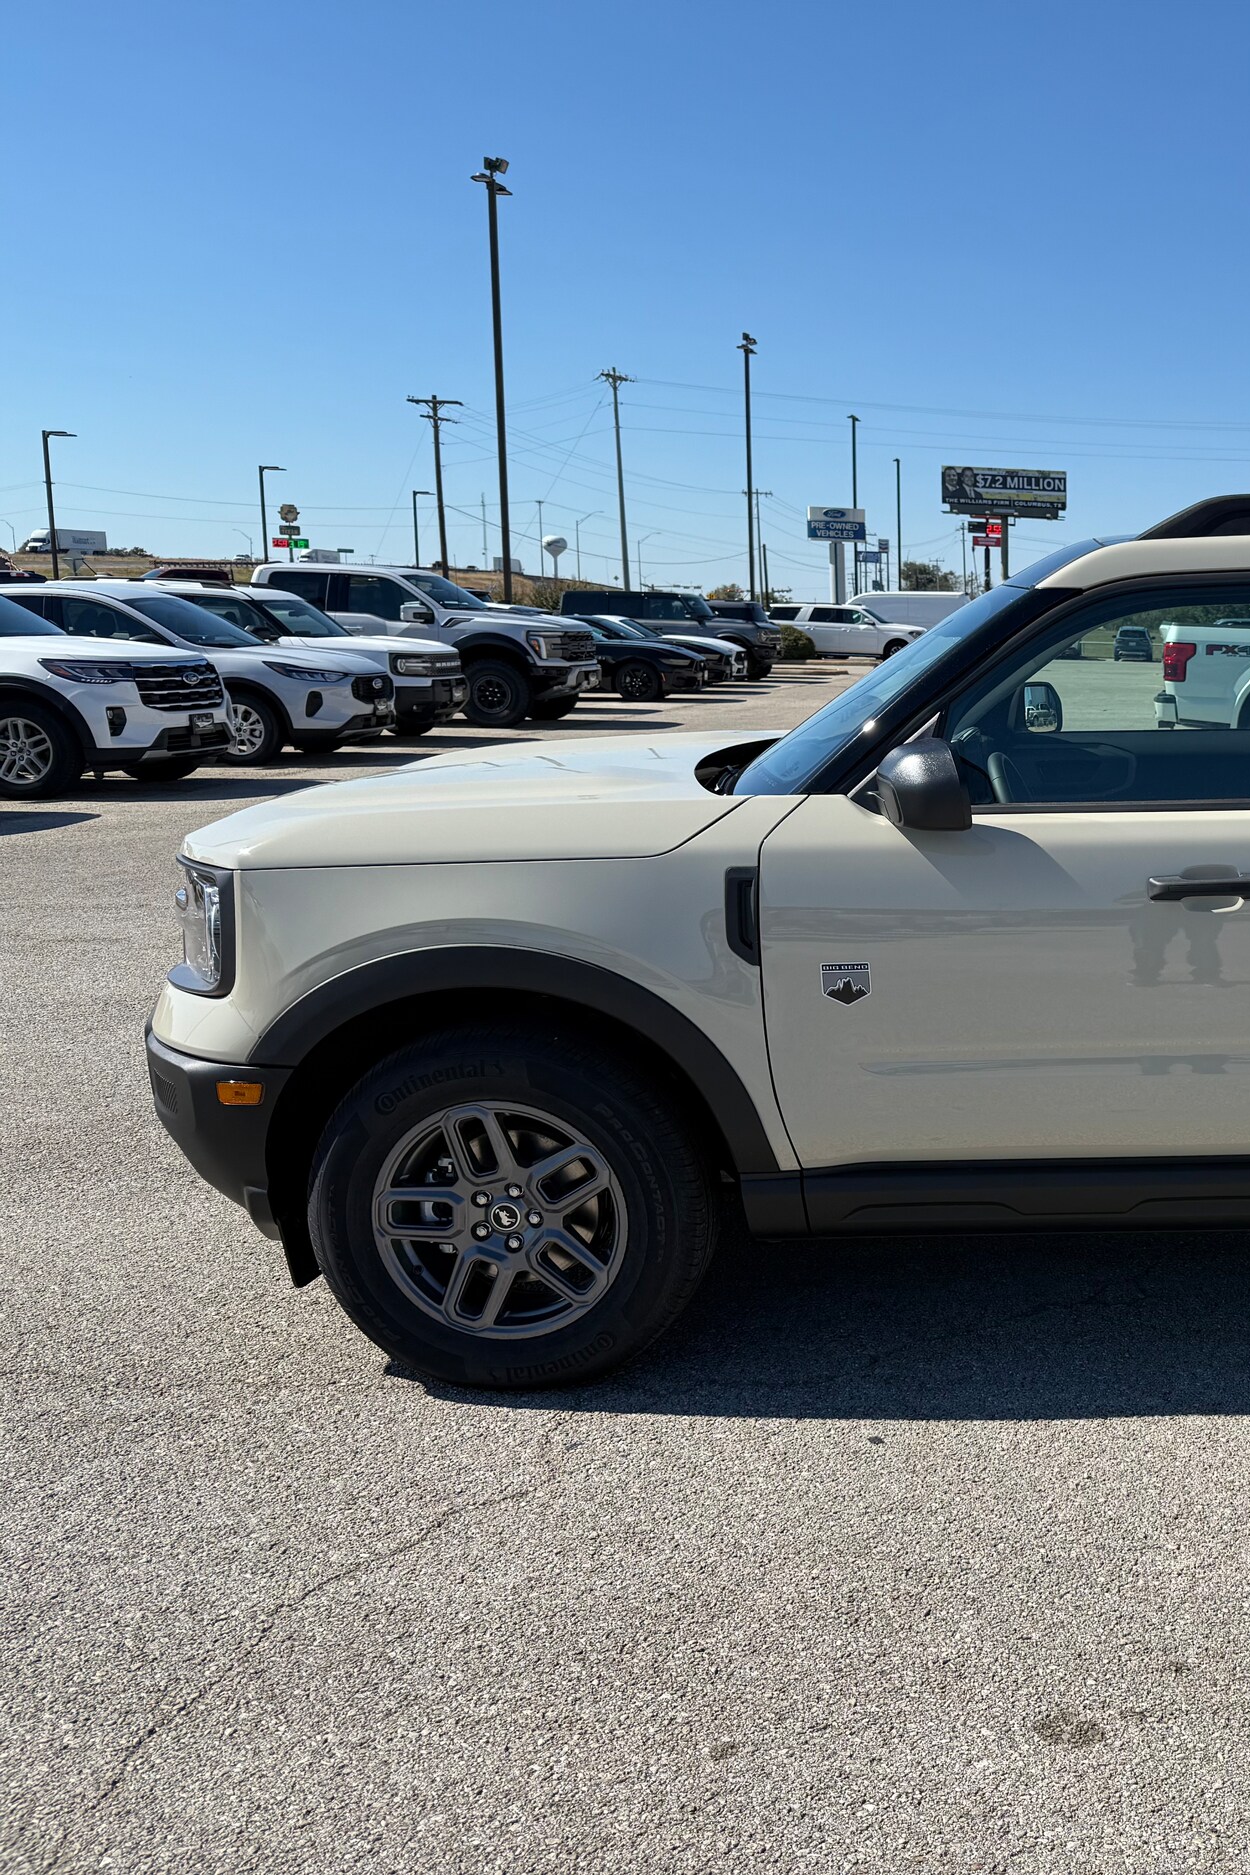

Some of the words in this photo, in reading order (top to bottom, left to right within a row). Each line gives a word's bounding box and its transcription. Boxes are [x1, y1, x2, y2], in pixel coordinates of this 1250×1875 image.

[976, 475, 1003, 488] $7.2
[1006, 477, 1065, 491] MILLION
[811, 522, 859, 530] PRE-OWNED
[816, 530, 854, 538] VEHICLES
[374, 1059, 485, 1115] Continental
